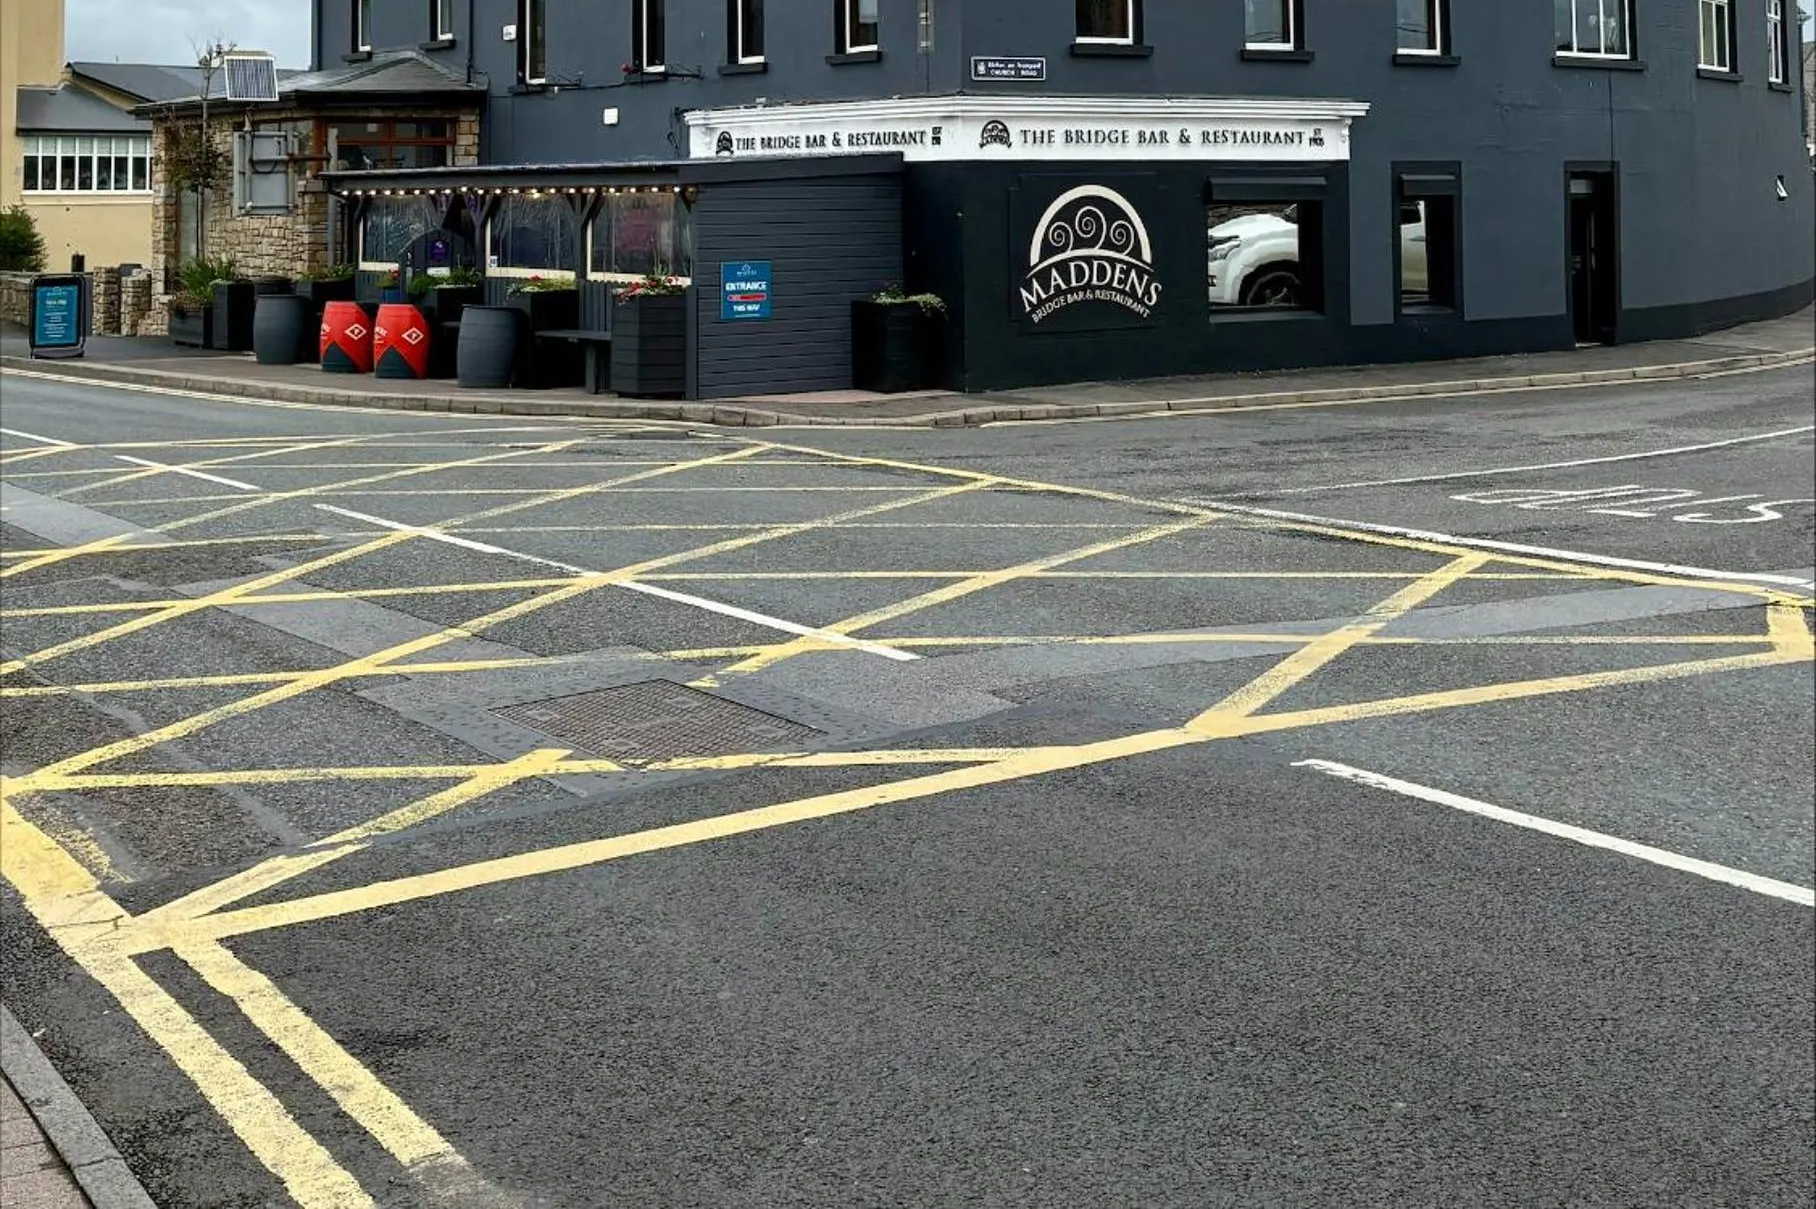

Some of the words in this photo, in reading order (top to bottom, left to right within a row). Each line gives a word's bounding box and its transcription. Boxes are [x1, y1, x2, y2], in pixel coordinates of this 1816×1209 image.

[735, 137, 756, 151] THE
[760, 135, 801, 149] BRIDGE
[805, 134, 826, 149] BAR
[831, 131, 842, 147] &
[847, 130, 926, 147] RESTAURANT
[1020, 129, 1056, 144] THE
[1065, 129, 1130, 144] BRIDGE
[1137, 130, 1170, 144] BAR
[1179, 128, 1191, 144] &
[1201, 130, 1305, 145] RESTAURANT
[725, 281, 767, 291] ENTRANCE
[1019, 259, 1162, 313] MADDENS
[1031, 294, 1067, 324] BRIDGE
[1066, 291, 1086, 304] BAR
[1085, 289, 1094, 300] &
[1094, 289, 1150, 318] RESTAURANT
